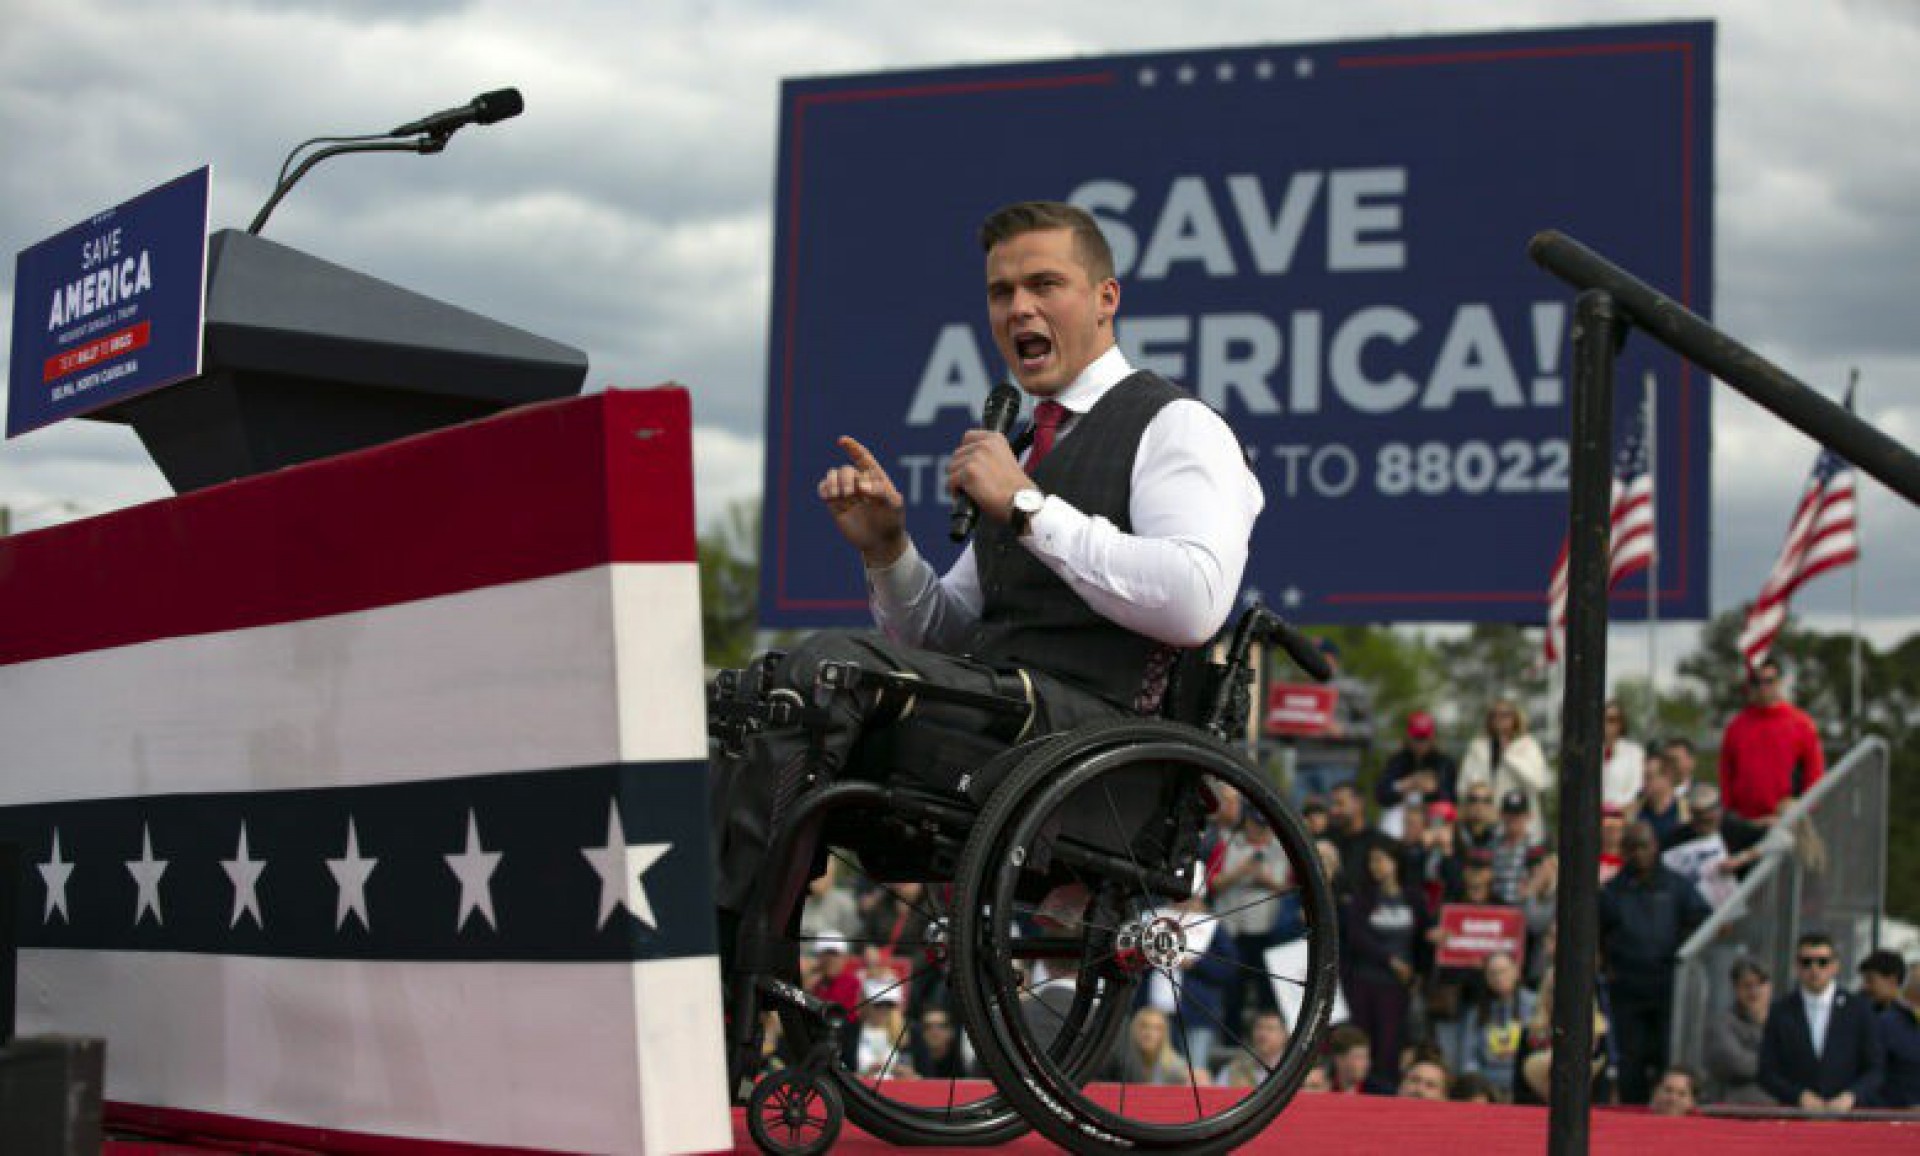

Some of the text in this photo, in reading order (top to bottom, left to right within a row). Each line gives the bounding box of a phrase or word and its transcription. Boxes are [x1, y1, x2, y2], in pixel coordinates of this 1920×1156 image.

[81, 227, 121, 269] SAVE
[1066, 167, 1407, 279] SAVE
[49, 249, 151, 332] AMERICA
[906, 302, 1564, 426] AERICA!
[1274, 443, 1359, 498] TO
[1375, 440, 1570, 494] 88022
